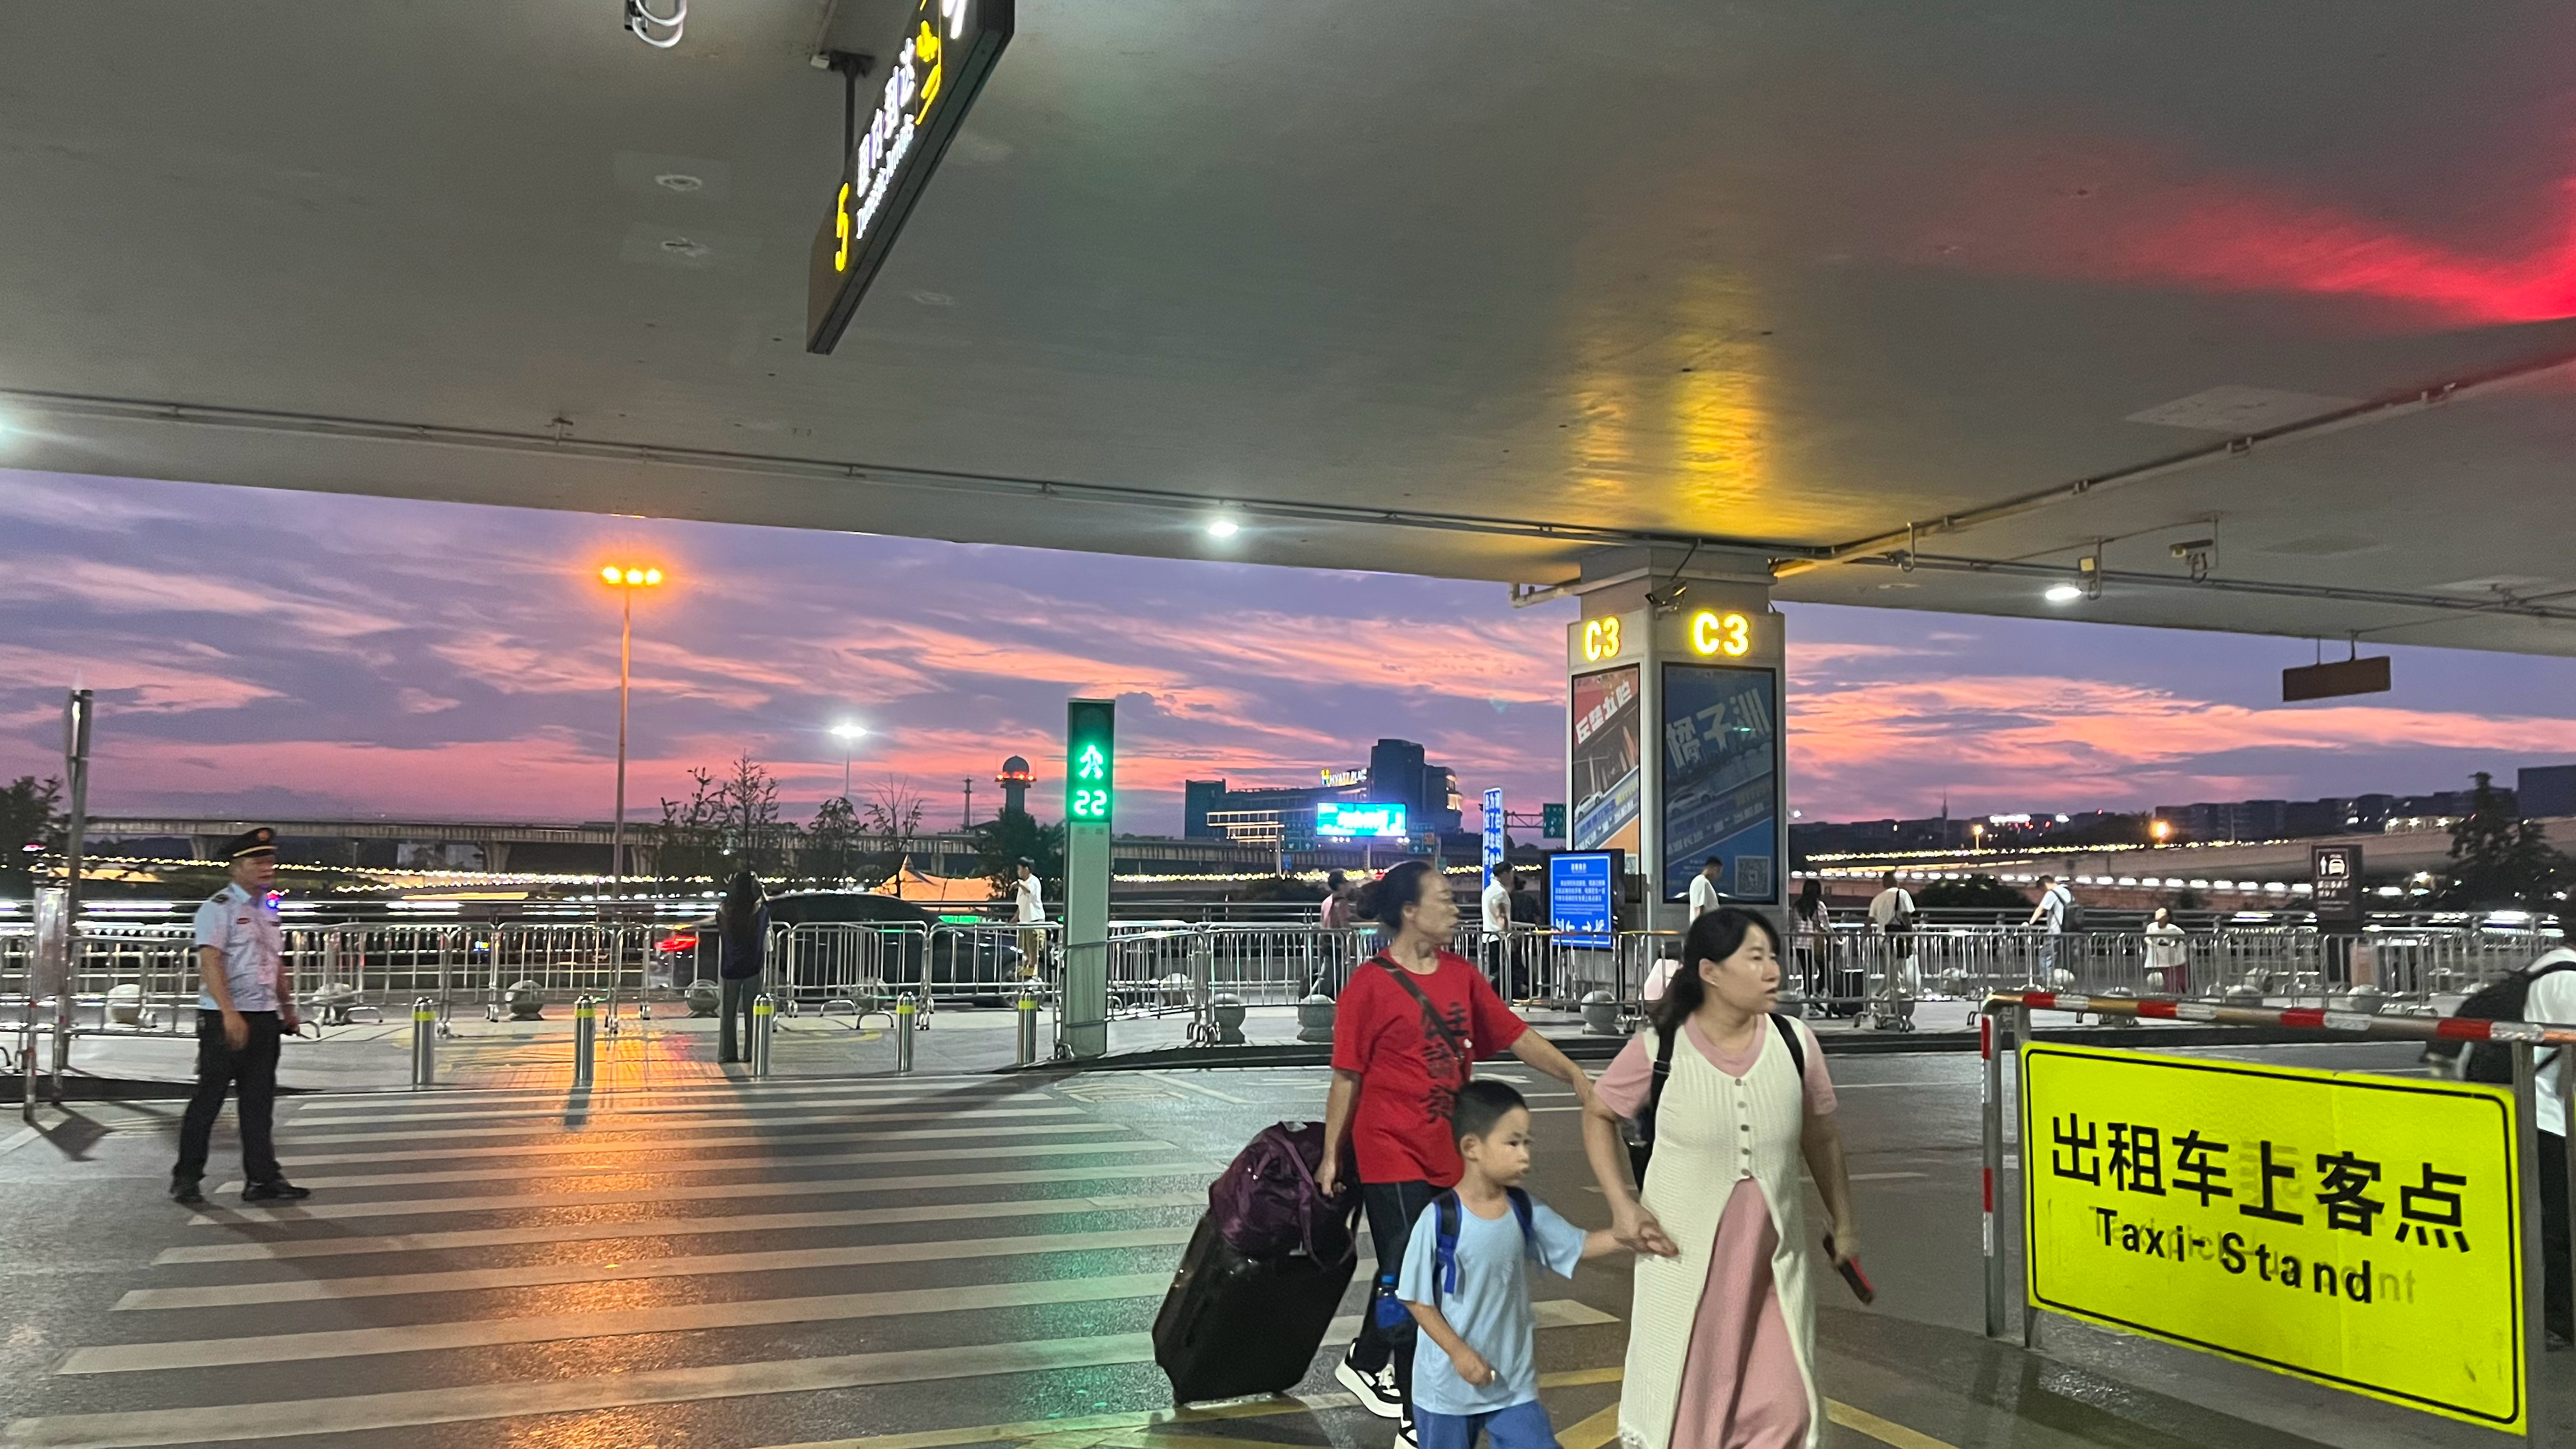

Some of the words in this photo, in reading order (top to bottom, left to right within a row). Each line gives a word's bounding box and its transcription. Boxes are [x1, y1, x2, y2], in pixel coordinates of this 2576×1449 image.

[1584, 615, 1621, 662] C3
[1693, 611, 1749, 657] C3
[1074, 789, 1107, 816] 22
[2052, 1112, 2471, 1253] 出租车上客点
